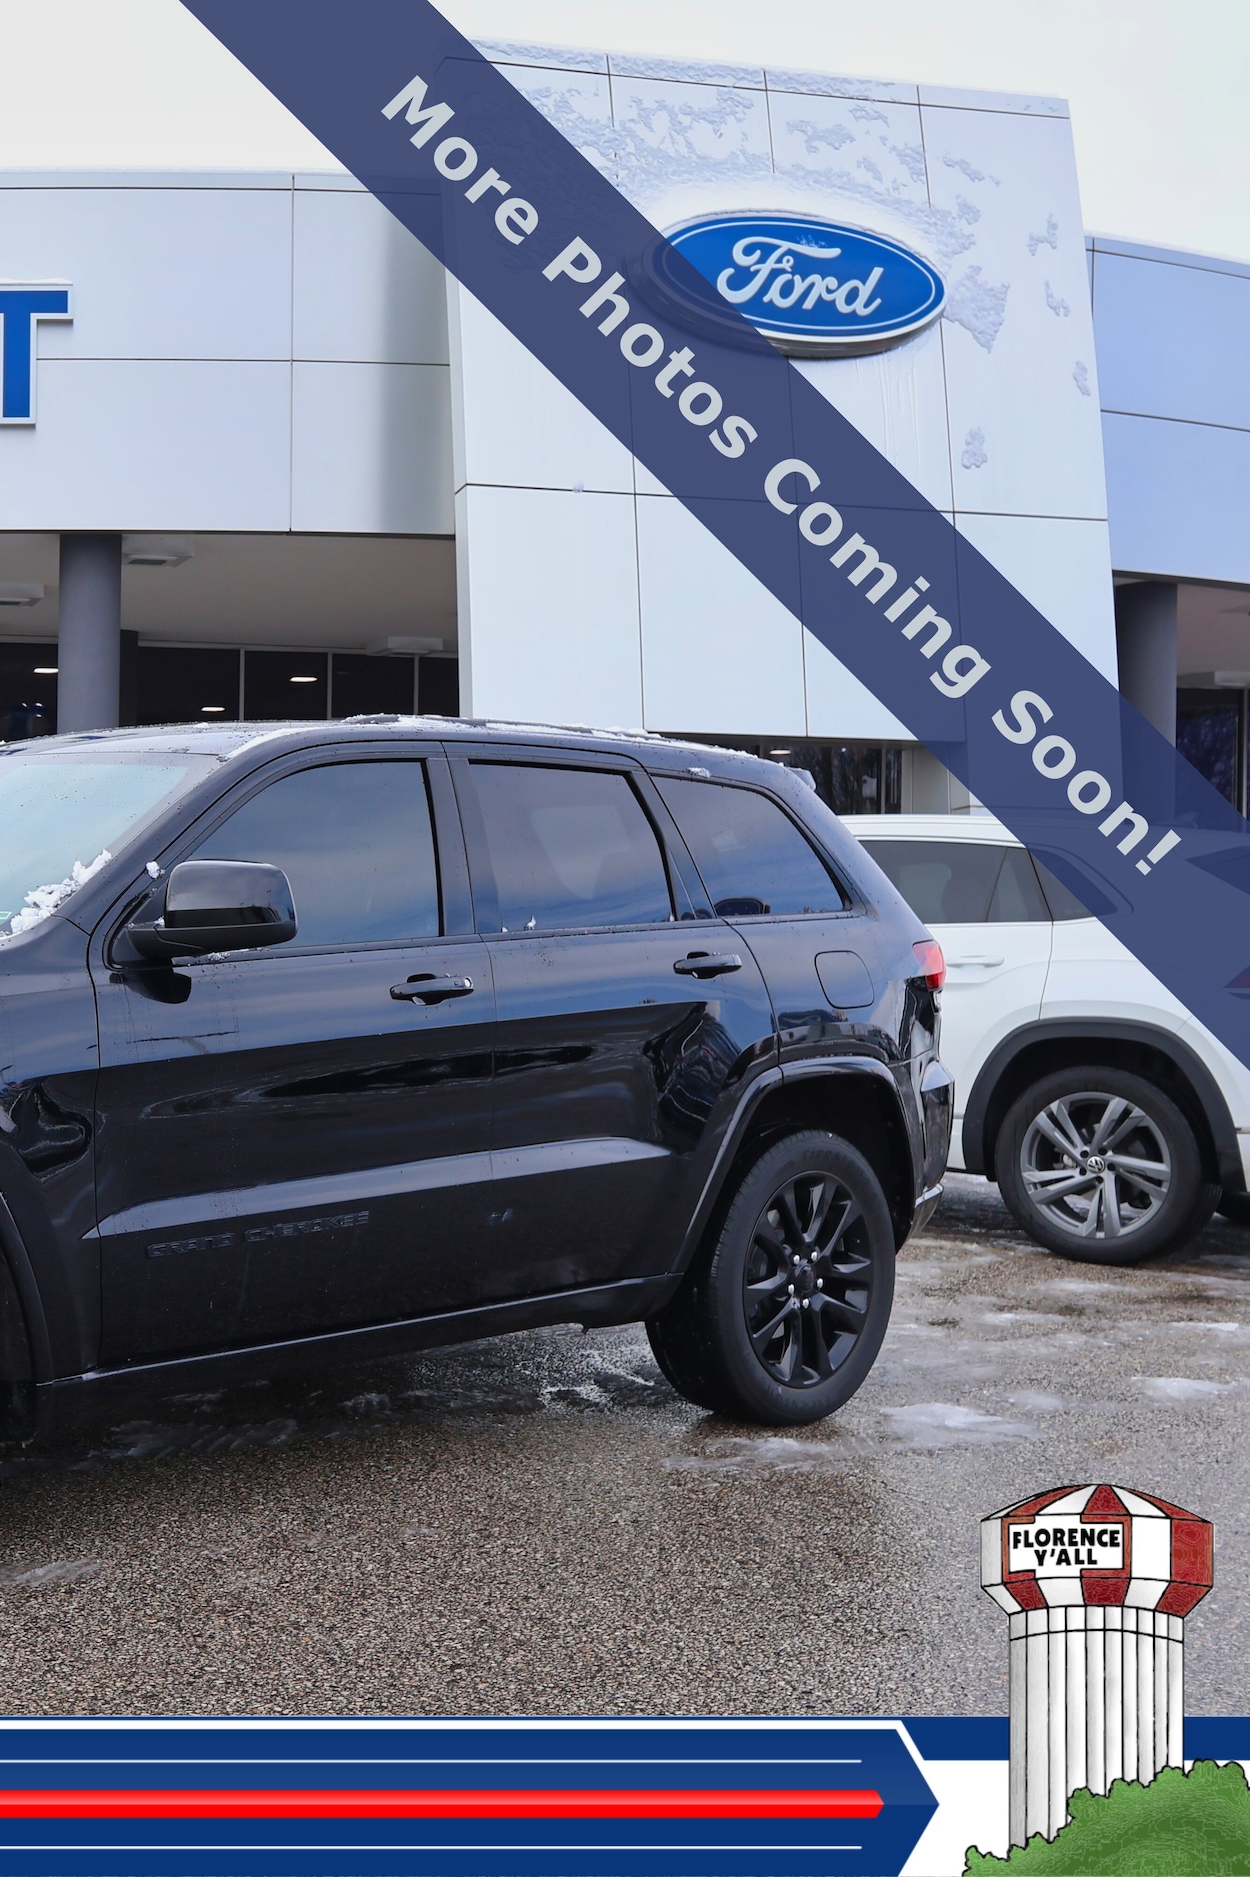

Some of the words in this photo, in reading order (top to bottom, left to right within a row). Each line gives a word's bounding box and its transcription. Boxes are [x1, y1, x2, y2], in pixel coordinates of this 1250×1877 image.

[717, 236, 884, 316] Ford
[147, 1233, 235, 1258] GRAND
[243, 1210, 370, 1243] CHEROKEE
